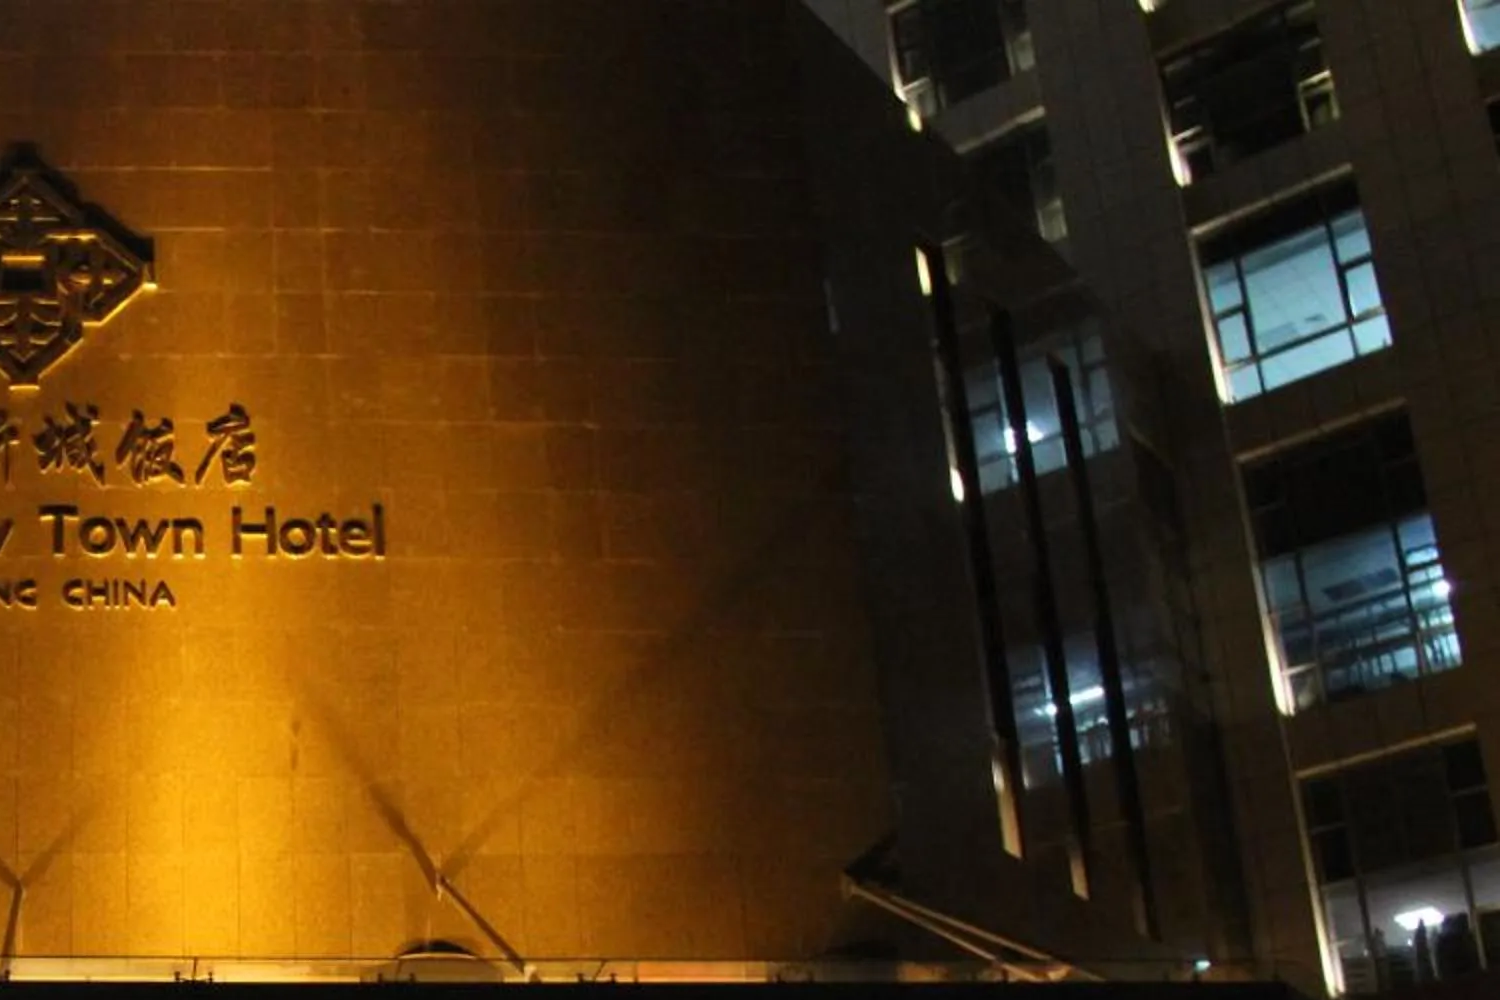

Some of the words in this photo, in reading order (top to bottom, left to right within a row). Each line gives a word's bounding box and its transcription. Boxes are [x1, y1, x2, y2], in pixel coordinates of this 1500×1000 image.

[39, 505, 205, 559] Town
[231, 503, 386, 560] Hotel
[61, 578, 176, 611] CHINA
